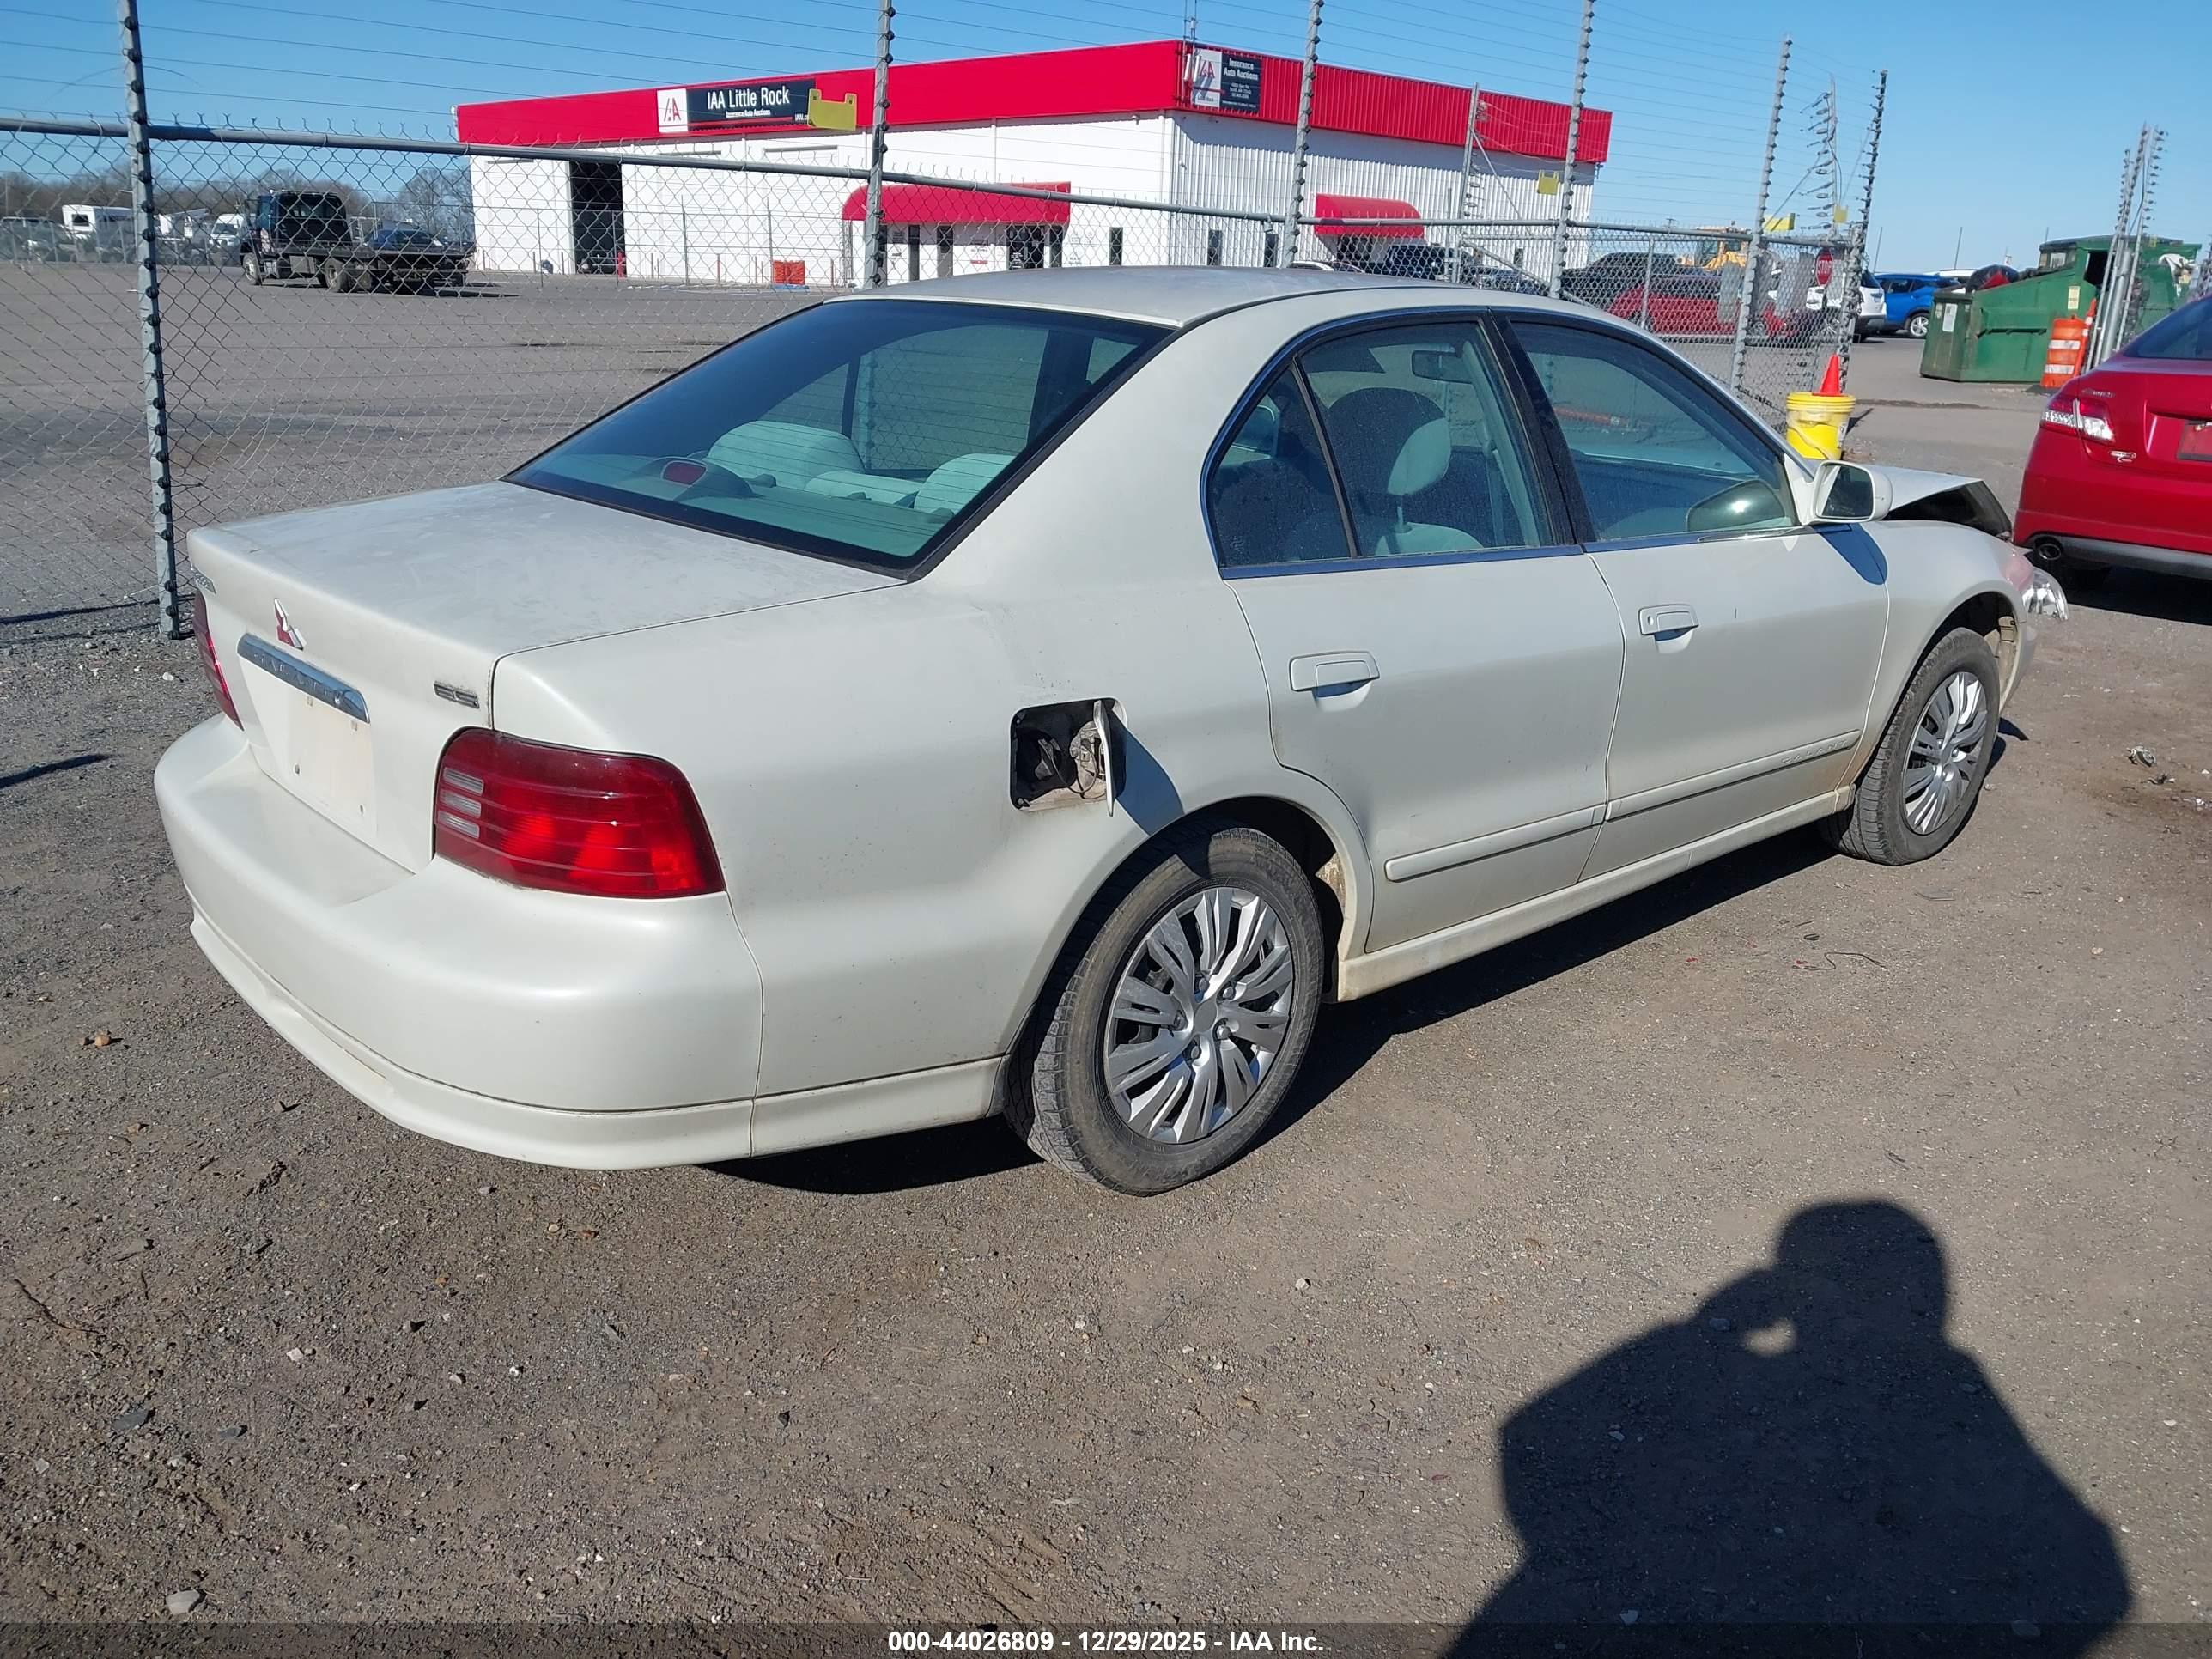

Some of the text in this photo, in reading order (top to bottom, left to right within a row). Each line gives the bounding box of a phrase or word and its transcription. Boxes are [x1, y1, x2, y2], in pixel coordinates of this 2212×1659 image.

[707, 85, 790, 110] IAA Little Rock
[1818, 259, 1832, 275] STOP
[1781, 739, 1848, 764] GALANT
